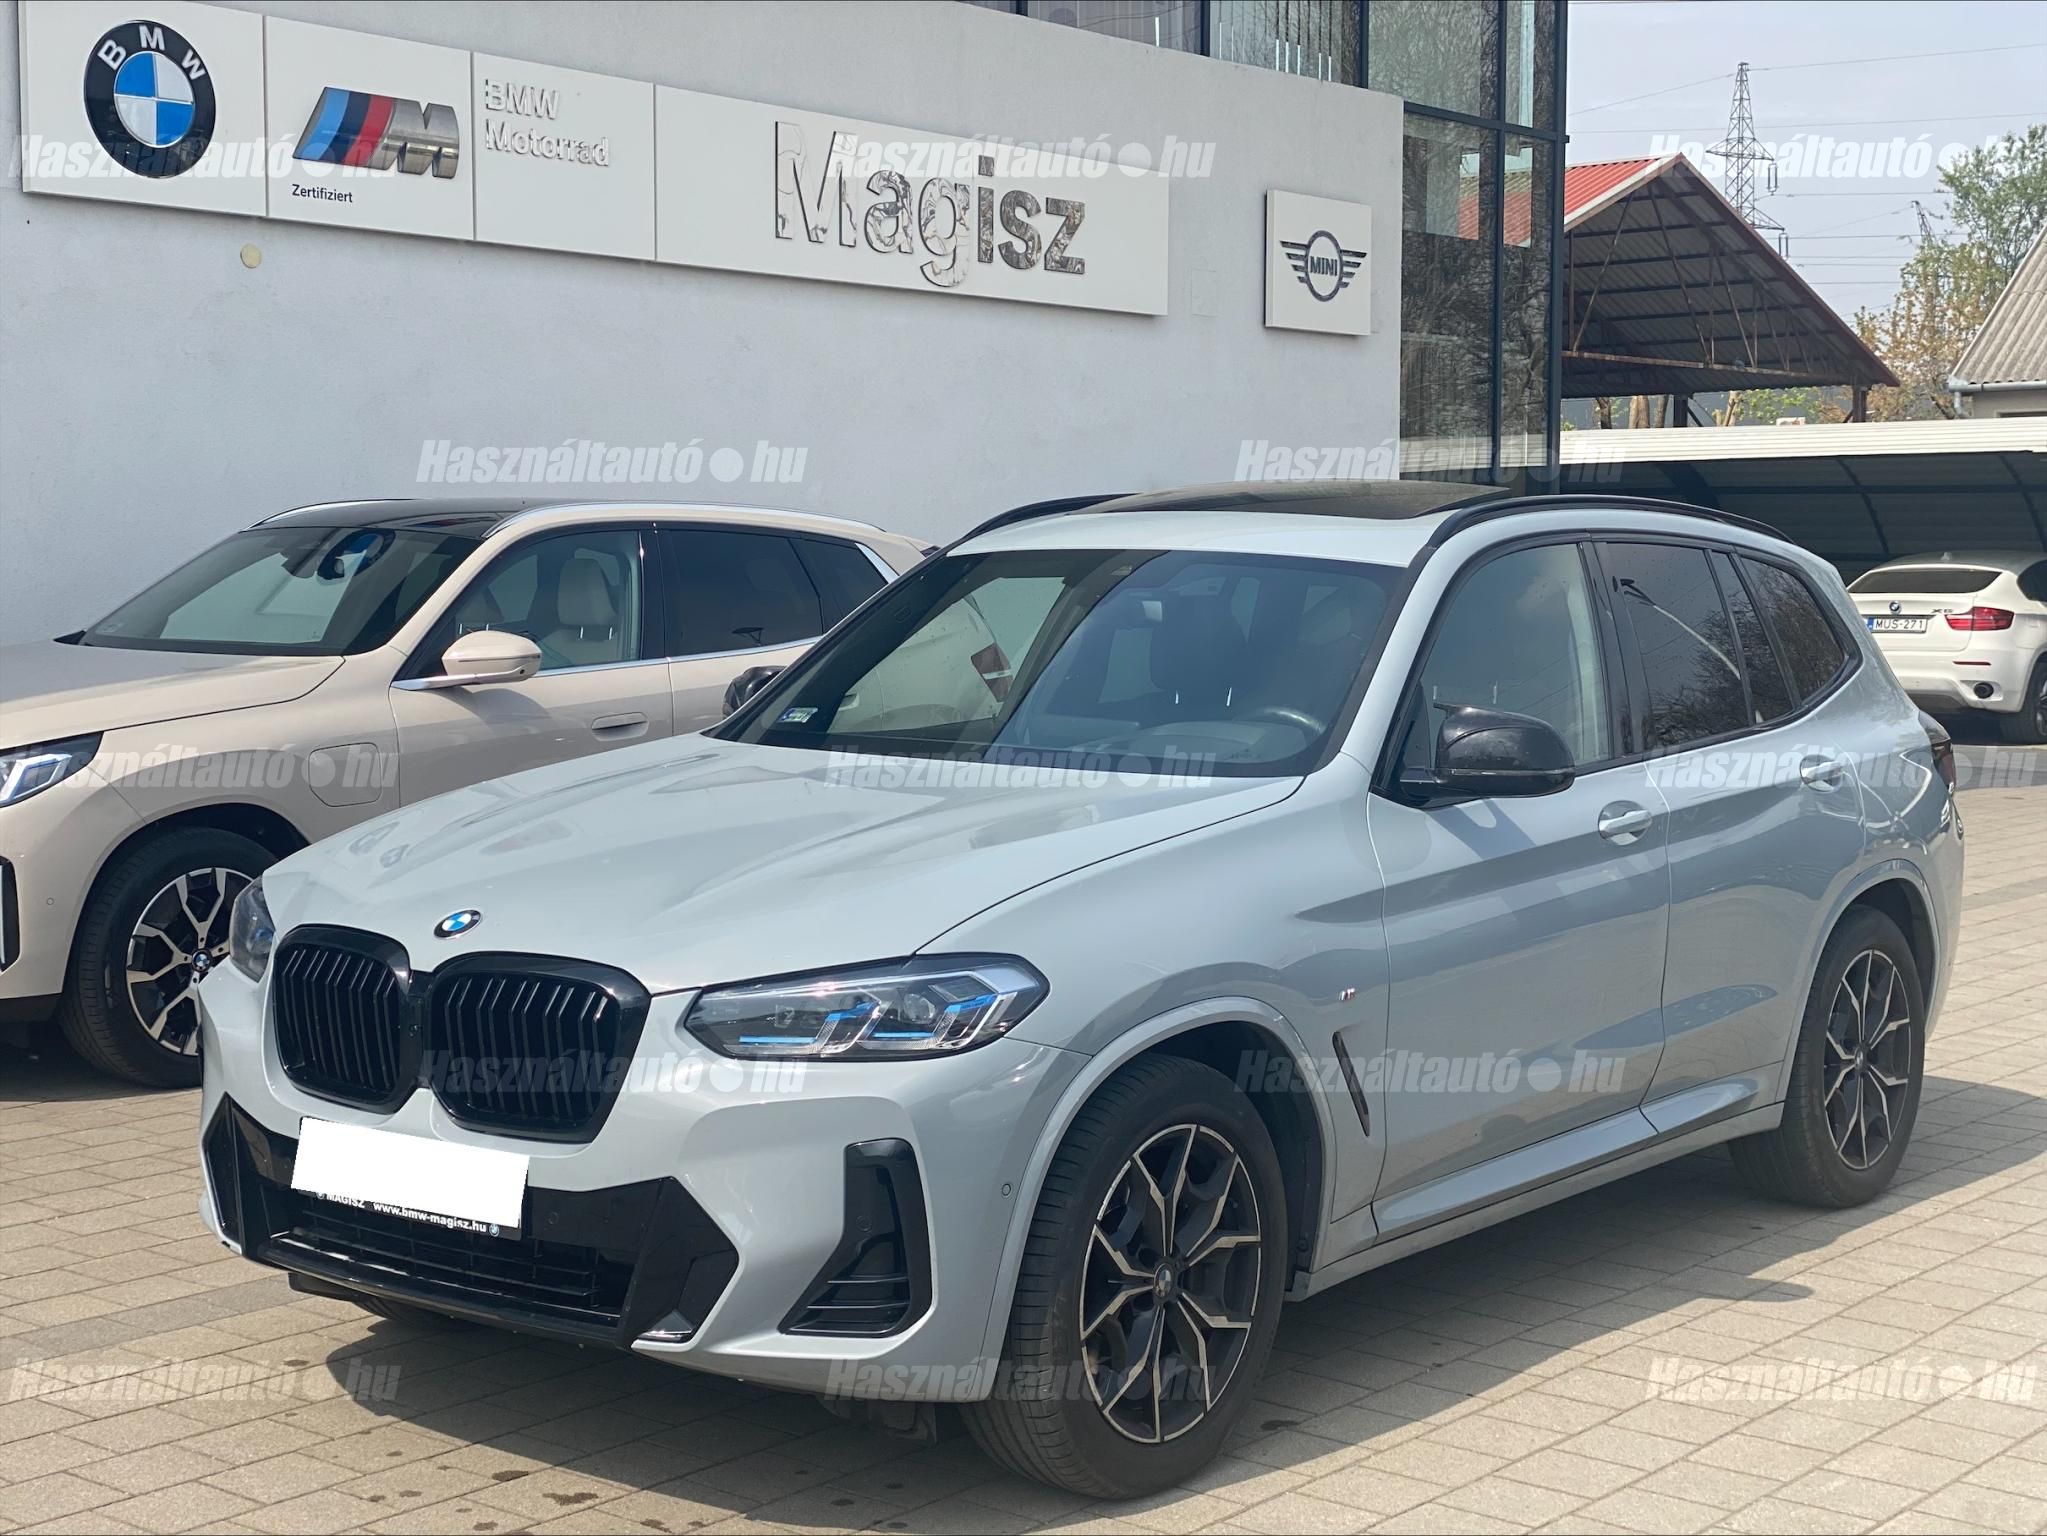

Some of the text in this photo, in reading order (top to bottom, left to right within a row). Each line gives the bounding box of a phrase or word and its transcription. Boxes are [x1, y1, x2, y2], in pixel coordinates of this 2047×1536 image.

[97, 25, 206, 80] BMW
[485, 79, 559, 120] BMW
[485, 119, 609, 167] Motorrad
[292, 184, 353, 203] Zertifiziert
[775, 121, 1086, 287] Magisz
[1310, 256, 1338, 277] MINI
[1876, 619, 1923, 630] MUS-271
[373, 1202, 487, 1233] www.bmw-magisz.hu
